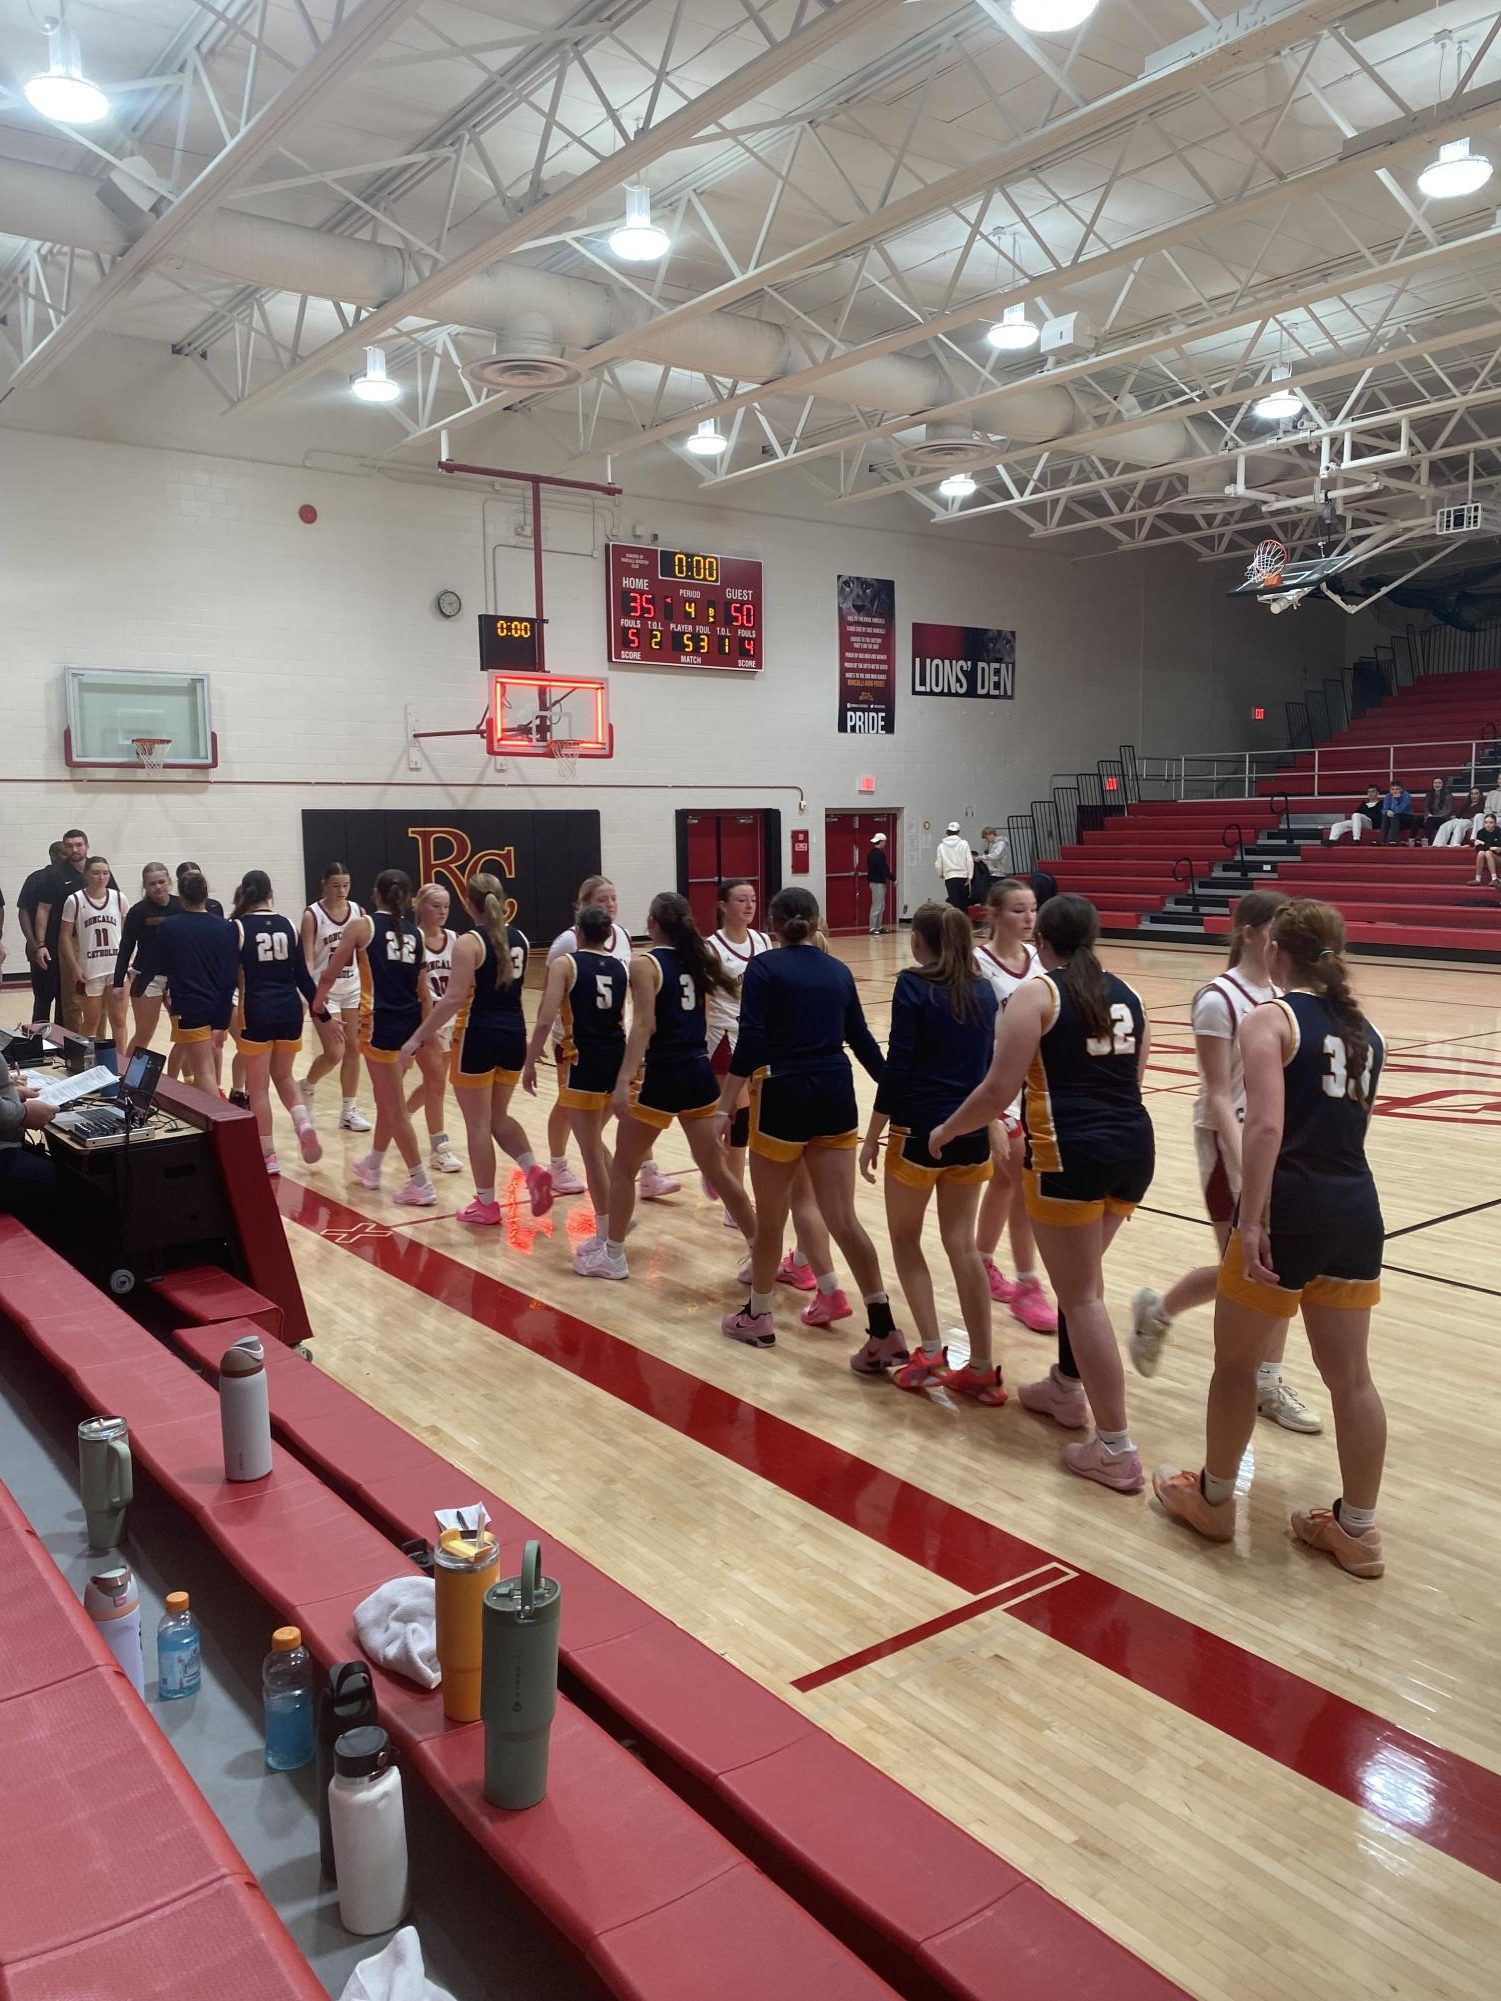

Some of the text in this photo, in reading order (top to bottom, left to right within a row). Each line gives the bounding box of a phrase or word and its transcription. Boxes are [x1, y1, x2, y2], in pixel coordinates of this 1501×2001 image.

[675, 554, 716, 580] 0:00
[622, 577, 649, 590] HOME
[680, 589, 701, 599] PERIOD
[726, 588, 753, 601] GUEST
[629, 592, 654, 617] 35
[685, 602, 695, 618] 4
[620, 618, 641, 628] FOULS
[731, 603, 754, 627] 50
[496, 620, 531, 638] 0:00
[628, 628, 639, 647] 5
[670, 623, 711, 634] PLAYER FOUL
[738, 629, 756, 638] FOULS
[651, 631, 661, 649] 2
[683, 633, 708, 653] 5 3
[725, 638, 729, 653] 1
[745, 640, 753, 655] 4
[621, 650, 641, 660] SCORE
[680, 655, 702, 664] MATCH
[738, 659, 756, 668] SCORE
[914, 657, 1012, 696] LIONS' DEN
[847, 711, 886, 734] PRIDE
[95, 928, 109, 947] 11
[256, 932, 289, 962] 20
[386, 931, 416, 964] 22
[596, 975, 613, 1010] 5
[679, 973, 696, 1011] 3
